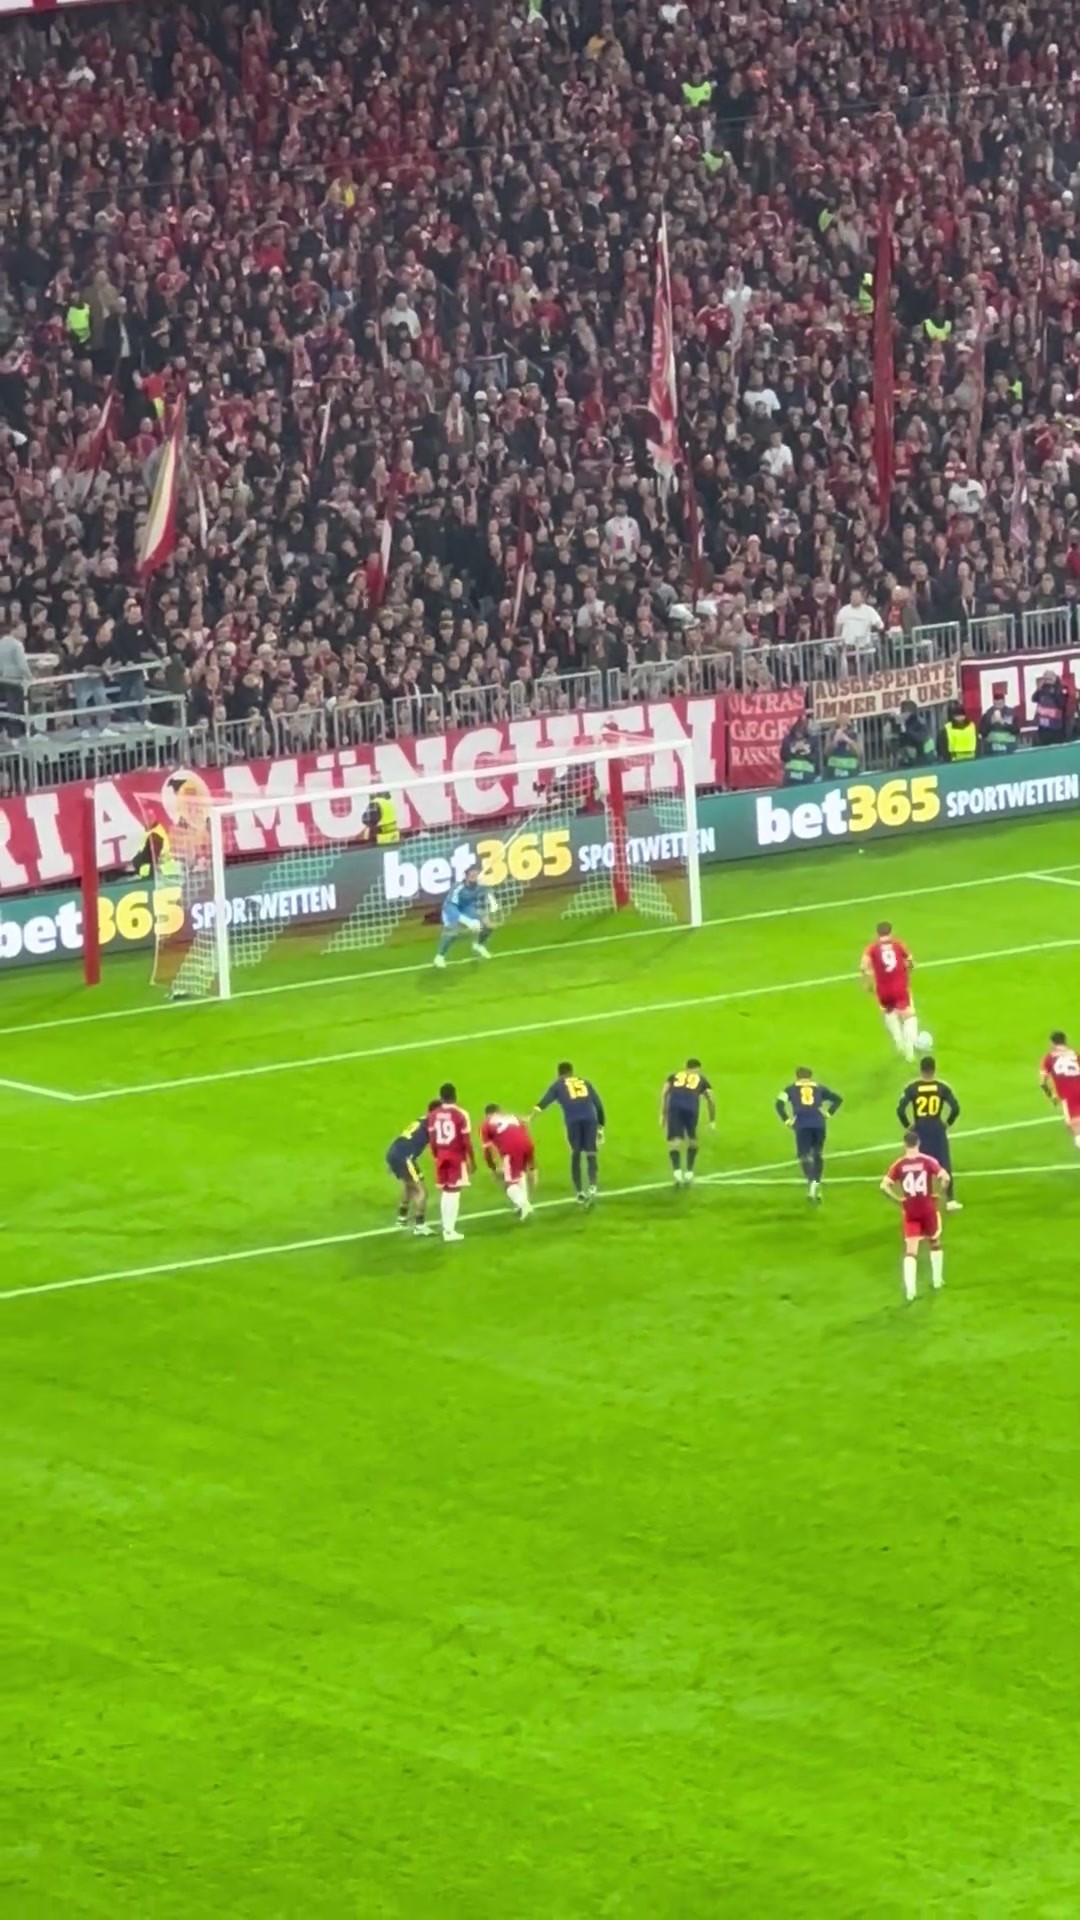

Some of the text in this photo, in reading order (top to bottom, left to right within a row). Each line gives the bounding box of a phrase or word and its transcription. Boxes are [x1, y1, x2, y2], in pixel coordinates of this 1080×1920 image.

[815, 661, 955, 700] AUSGESPERRTE
[728, 691, 805, 715] ULTRAS
[815, 681, 953, 719] IMMER BEI UNS
[730, 716, 799, 741] GEGE
[223, 698, 717, 851] MÜNCHEN
[756, 773, 1079, 845] bet365 SPORTWETTEN
[383, 830, 573, 899] bet365
[881, 949, 898, 973] 9
[565, 1078, 589, 1099] 15
[915, 1095, 940, 1117] 20
[433, 1119, 456, 1145] 19
[902, 1170, 928, 1197] 44
